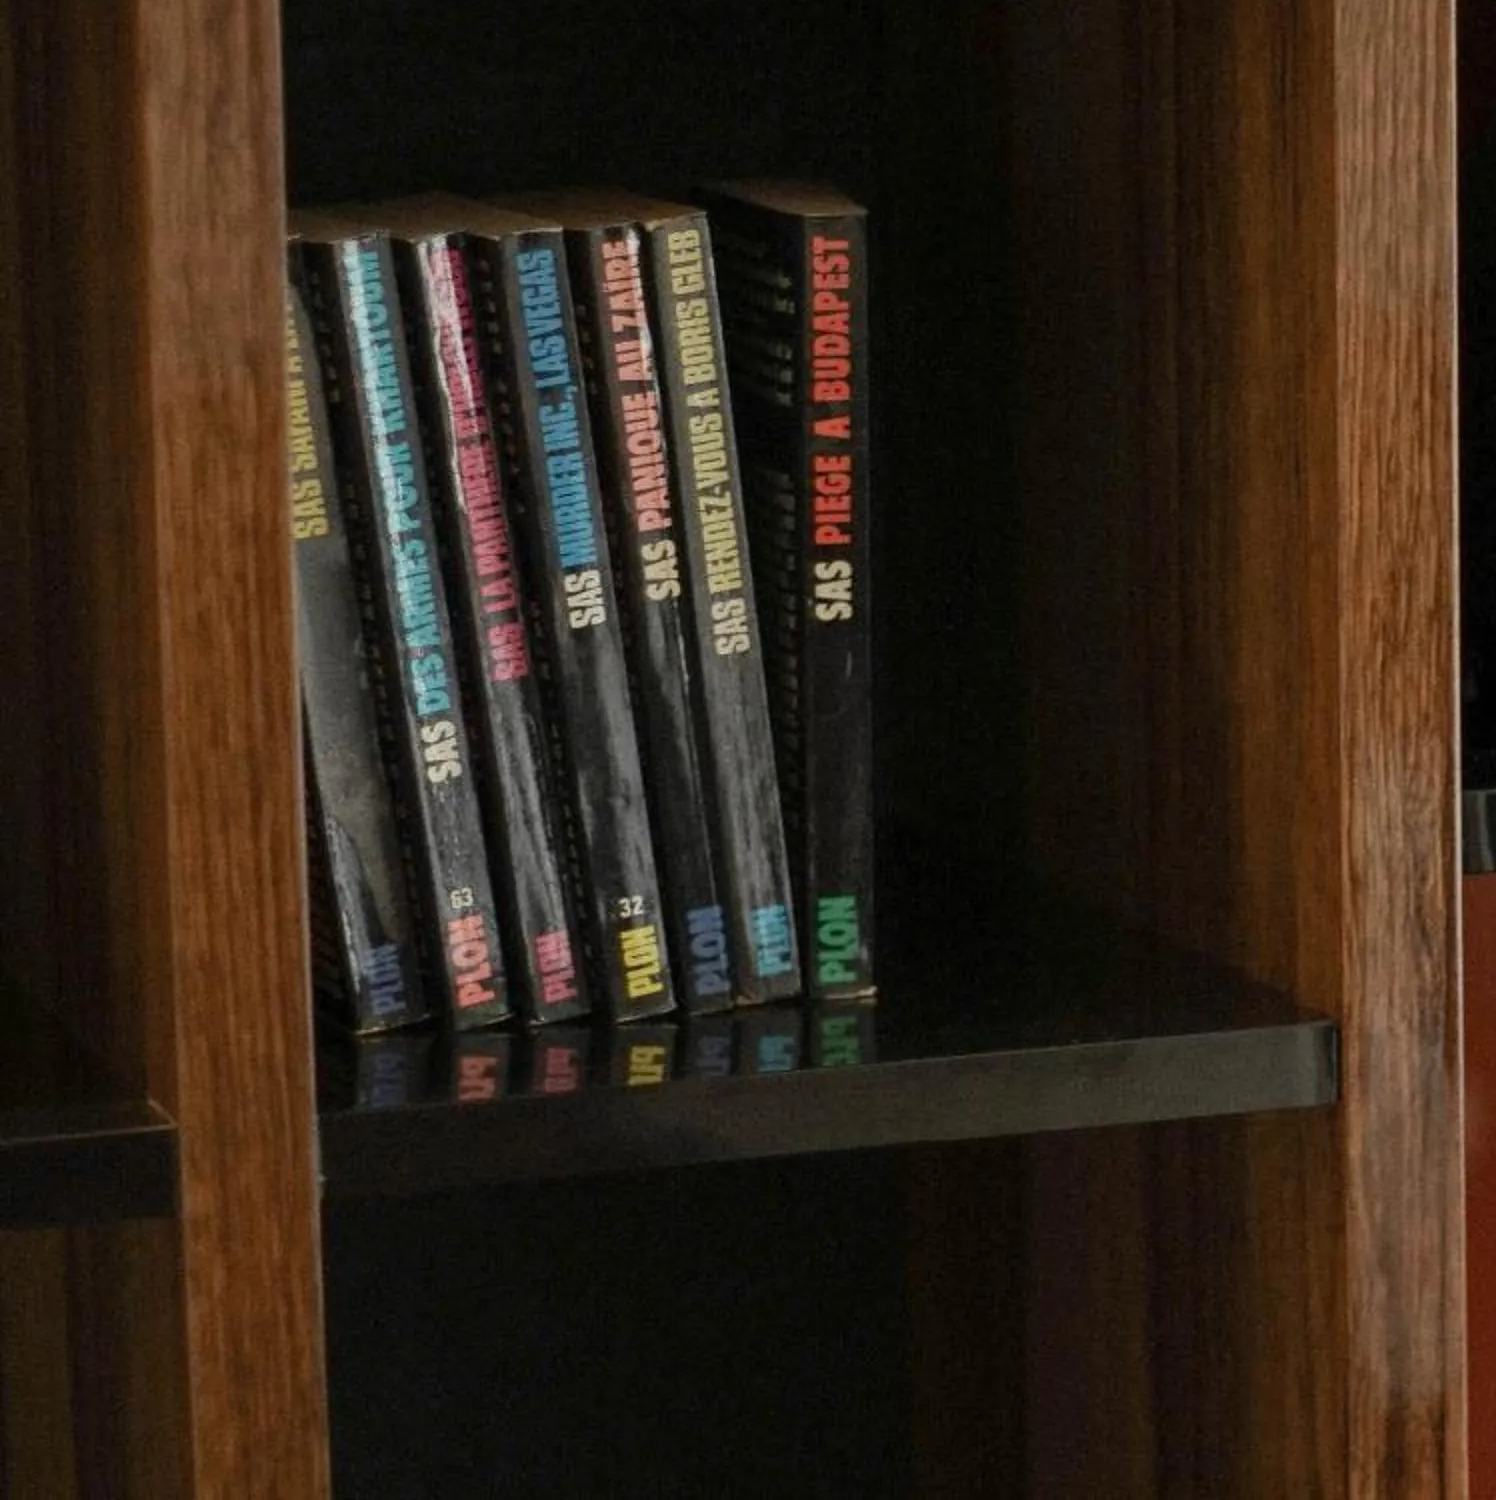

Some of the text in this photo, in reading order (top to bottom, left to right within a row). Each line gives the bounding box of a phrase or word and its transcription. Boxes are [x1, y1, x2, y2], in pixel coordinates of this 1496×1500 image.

[667, 228, 706, 296] GLEB
[615, 341, 654, 381] AU
[676, 297, 717, 386] BORIS
[621, 390, 672, 532] PANIQUE
[812, 236, 853, 622] SAS PIEGE A BUDAPEST
[288, 478, 330, 540] SAS
[344, 244, 462, 784] SAS DES ARMES POUR KHARTOUM
[545, 452, 598, 569] MURDER
[689, 412, 744, 594] RENDEZ-VOUS
[479, 577, 519, 613] LA
[563, 569, 607, 630] SAS
[641, 539, 682, 601] SAS
[487, 621, 530, 681] SAS
[711, 597, 751, 656] SAS
[450, 888, 474, 909] 63
[619, 896, 643, 918] 32
[447, 913, 496, 1009] PLON
[534, 929, 578, 1004] PLON
[619, 924, 664, 999] PLON
[687, 903, 731, 996] PLON
[753, 903, 792, 978] PLON
[816, 896, 859, 984] PLON
[364, 943, 407, 1016] PLON
